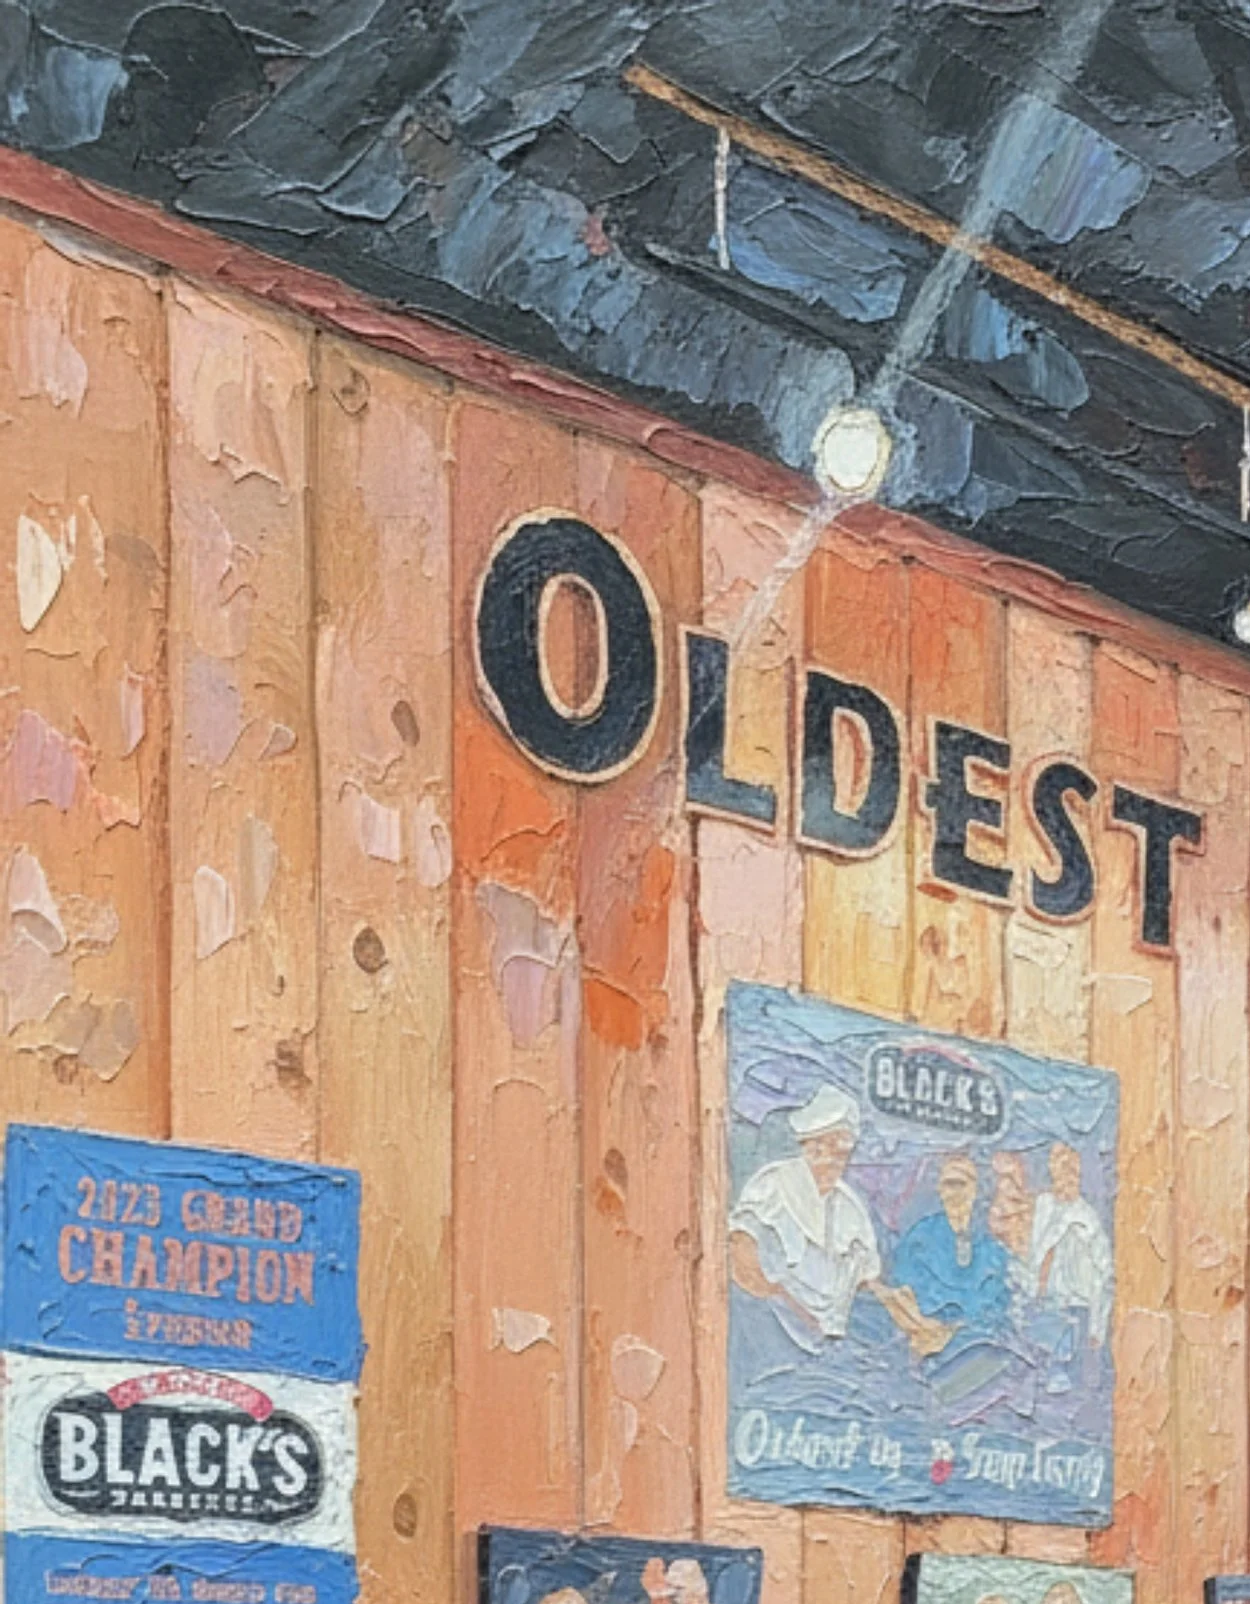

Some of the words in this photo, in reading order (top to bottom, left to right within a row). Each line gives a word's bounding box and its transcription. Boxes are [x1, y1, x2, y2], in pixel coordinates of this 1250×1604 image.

[475, 508, 1203, 952] OLDEST
[57, 1224, 315, 1305] CHAMPION
[52, 1411, 309, 1497] BLACK'S
